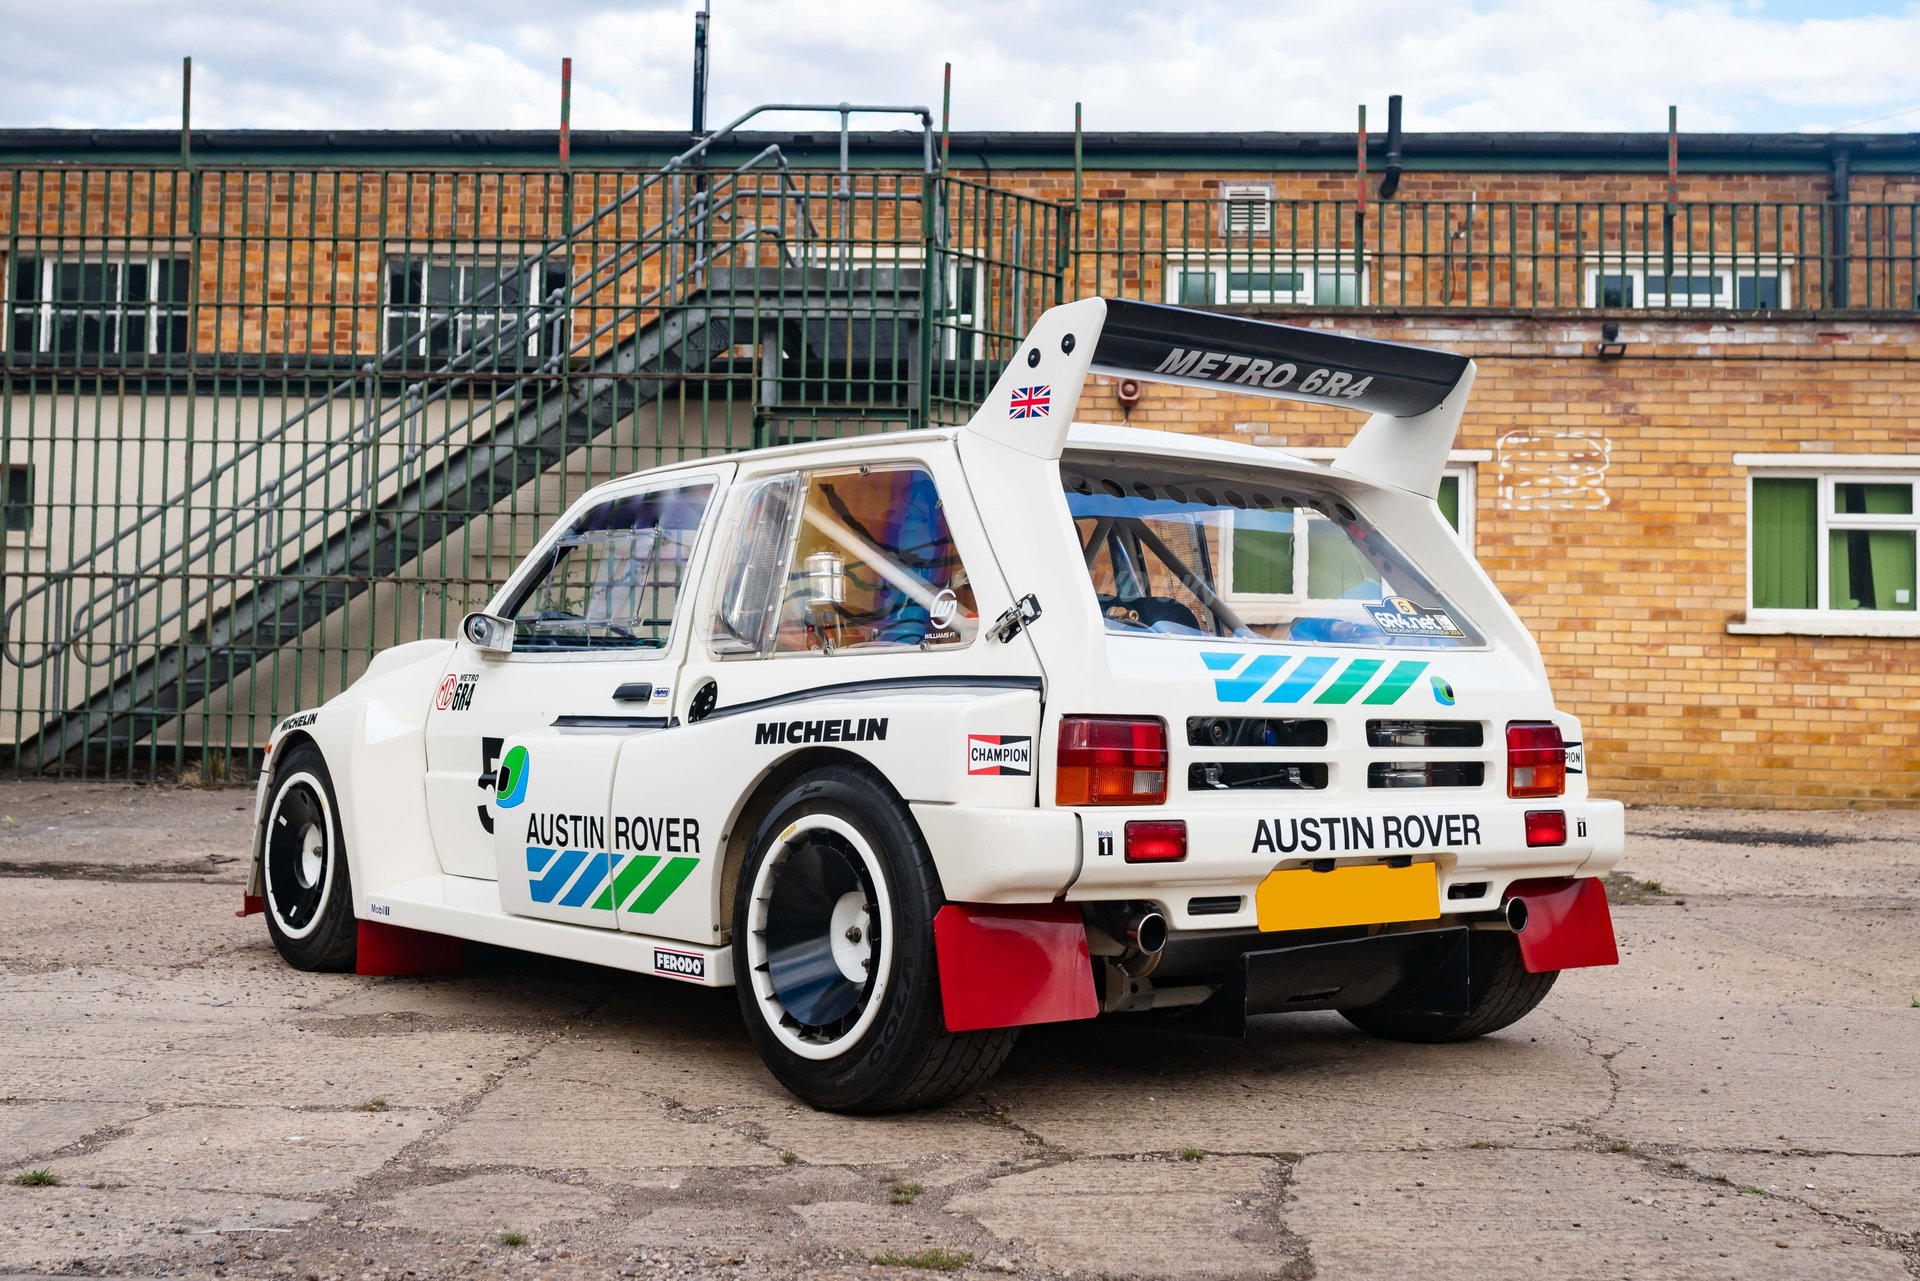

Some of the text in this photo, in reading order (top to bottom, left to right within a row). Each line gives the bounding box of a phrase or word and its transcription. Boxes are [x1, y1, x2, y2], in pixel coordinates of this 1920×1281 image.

[1153, 347, 1375, 400] METRO 6R4
[1398, 601, 1410, 613] 6
[1374, 611, 1443, 630] 6R4.net
[924, 631, 950, 639] WILLIAMS
[459, 674, 480, 682] METRO
[437, 677, 456, 707] MG
[451, 682, 476, 711] 6R4
[280, 712, 319, 732] MICHELIN
[754, 717, 889, 745] MICHELIN
[971, 747, 1029, 763] CHAMPION
[526, 812, 701, 854] AUSTIN ROVER
[1251, 814, 1482, 854] AUSTIN ROVER
[1102, 837, 1109, 855] 1
[371, 903, 385, 915] Mobil
[656, 952, 702, 975] FERODO
